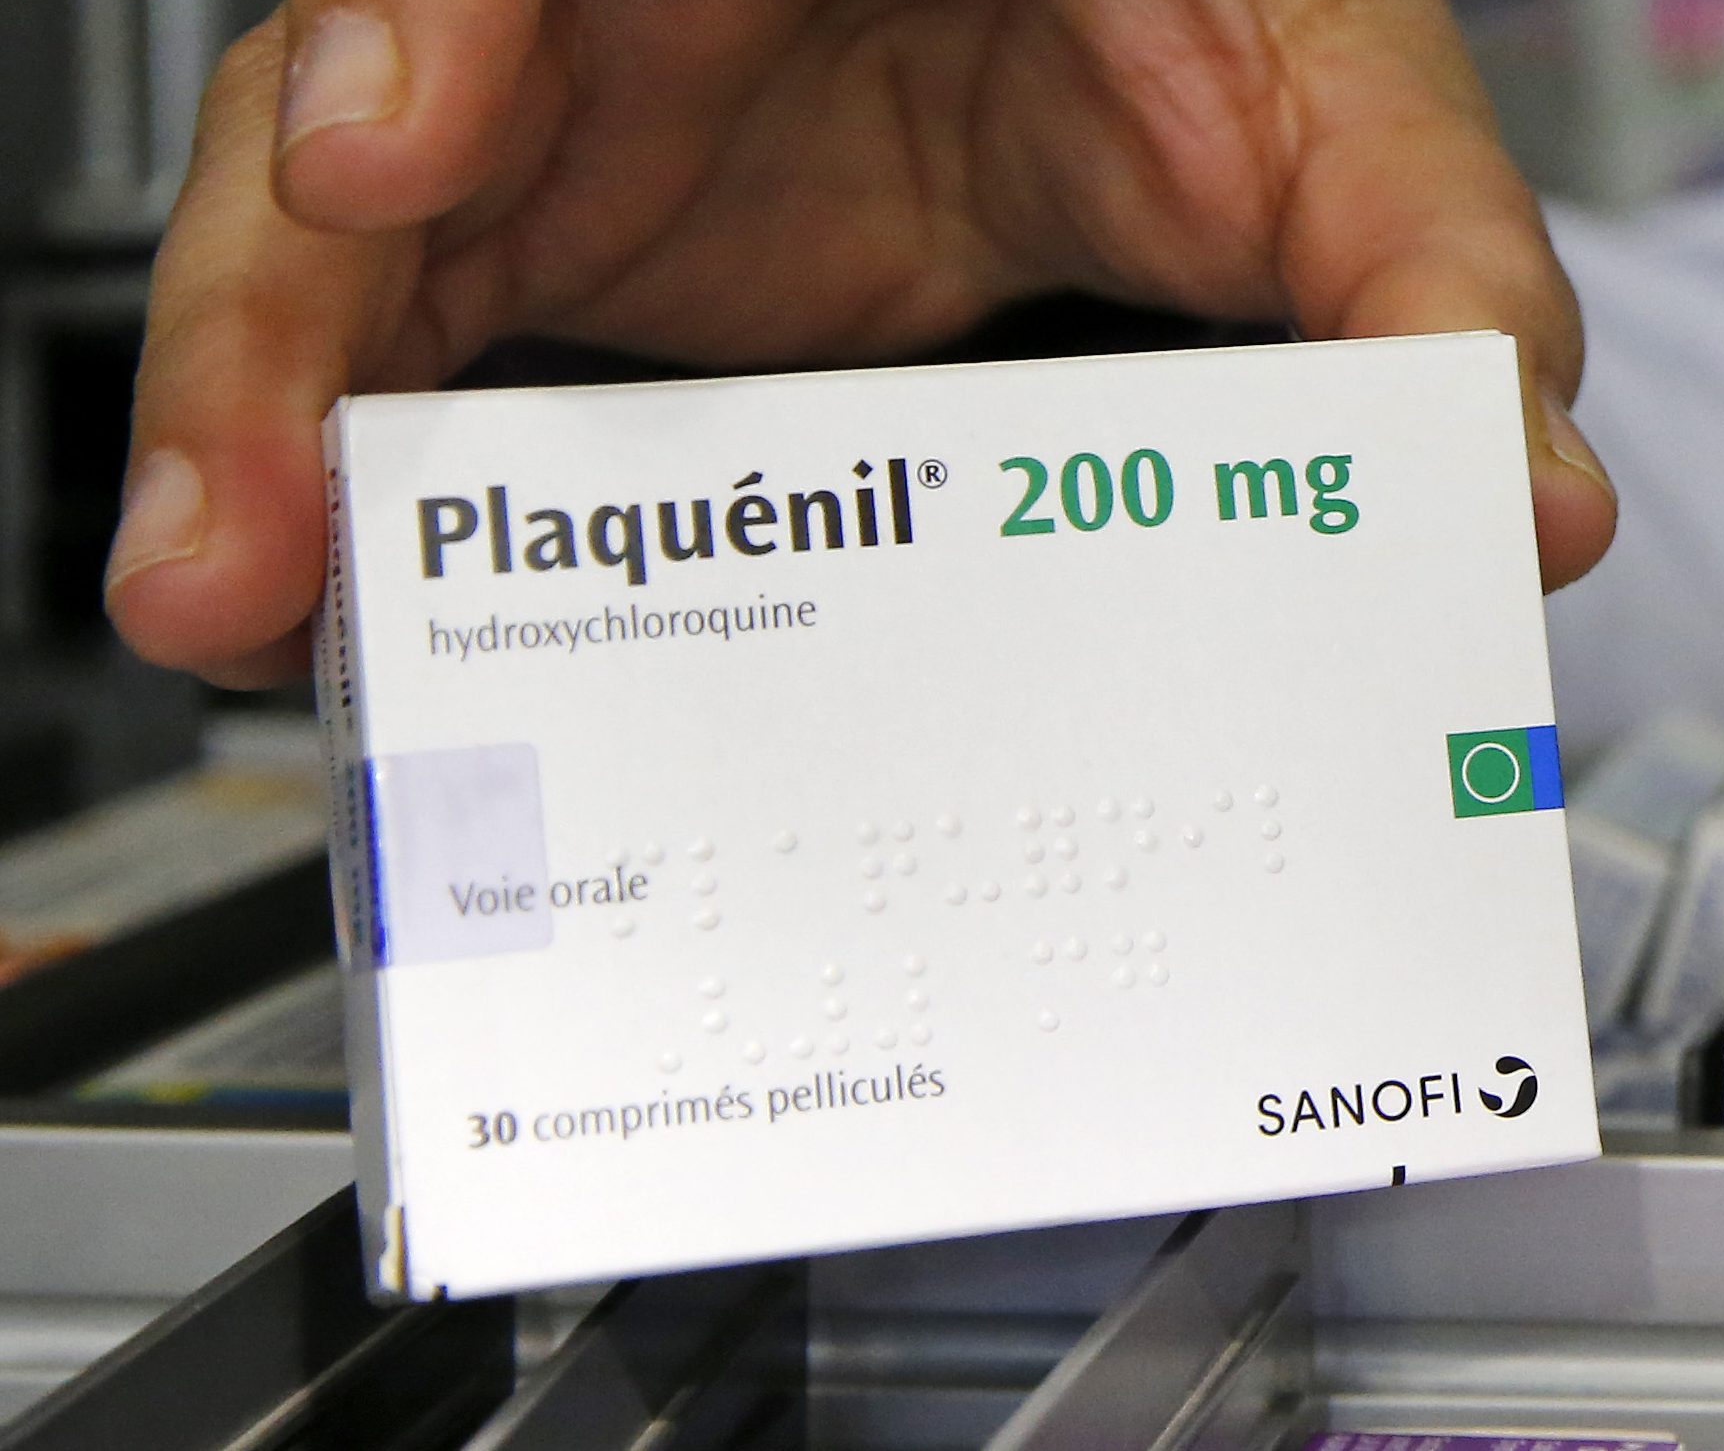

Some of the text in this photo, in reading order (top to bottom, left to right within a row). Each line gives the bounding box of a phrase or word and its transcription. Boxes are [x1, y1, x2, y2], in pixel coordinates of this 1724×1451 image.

[997, 447, 1176, 538] 200
[1212, 454, 1361, 536] mg
[428, 593, 818, 663] hydroxychloroquine
[449, 862, 650, 917] Voie orale
[467, 1063, 947, 1150] 30 comprimés pelliculés
[1256, 1072, 1462, 1138] SANOFI
